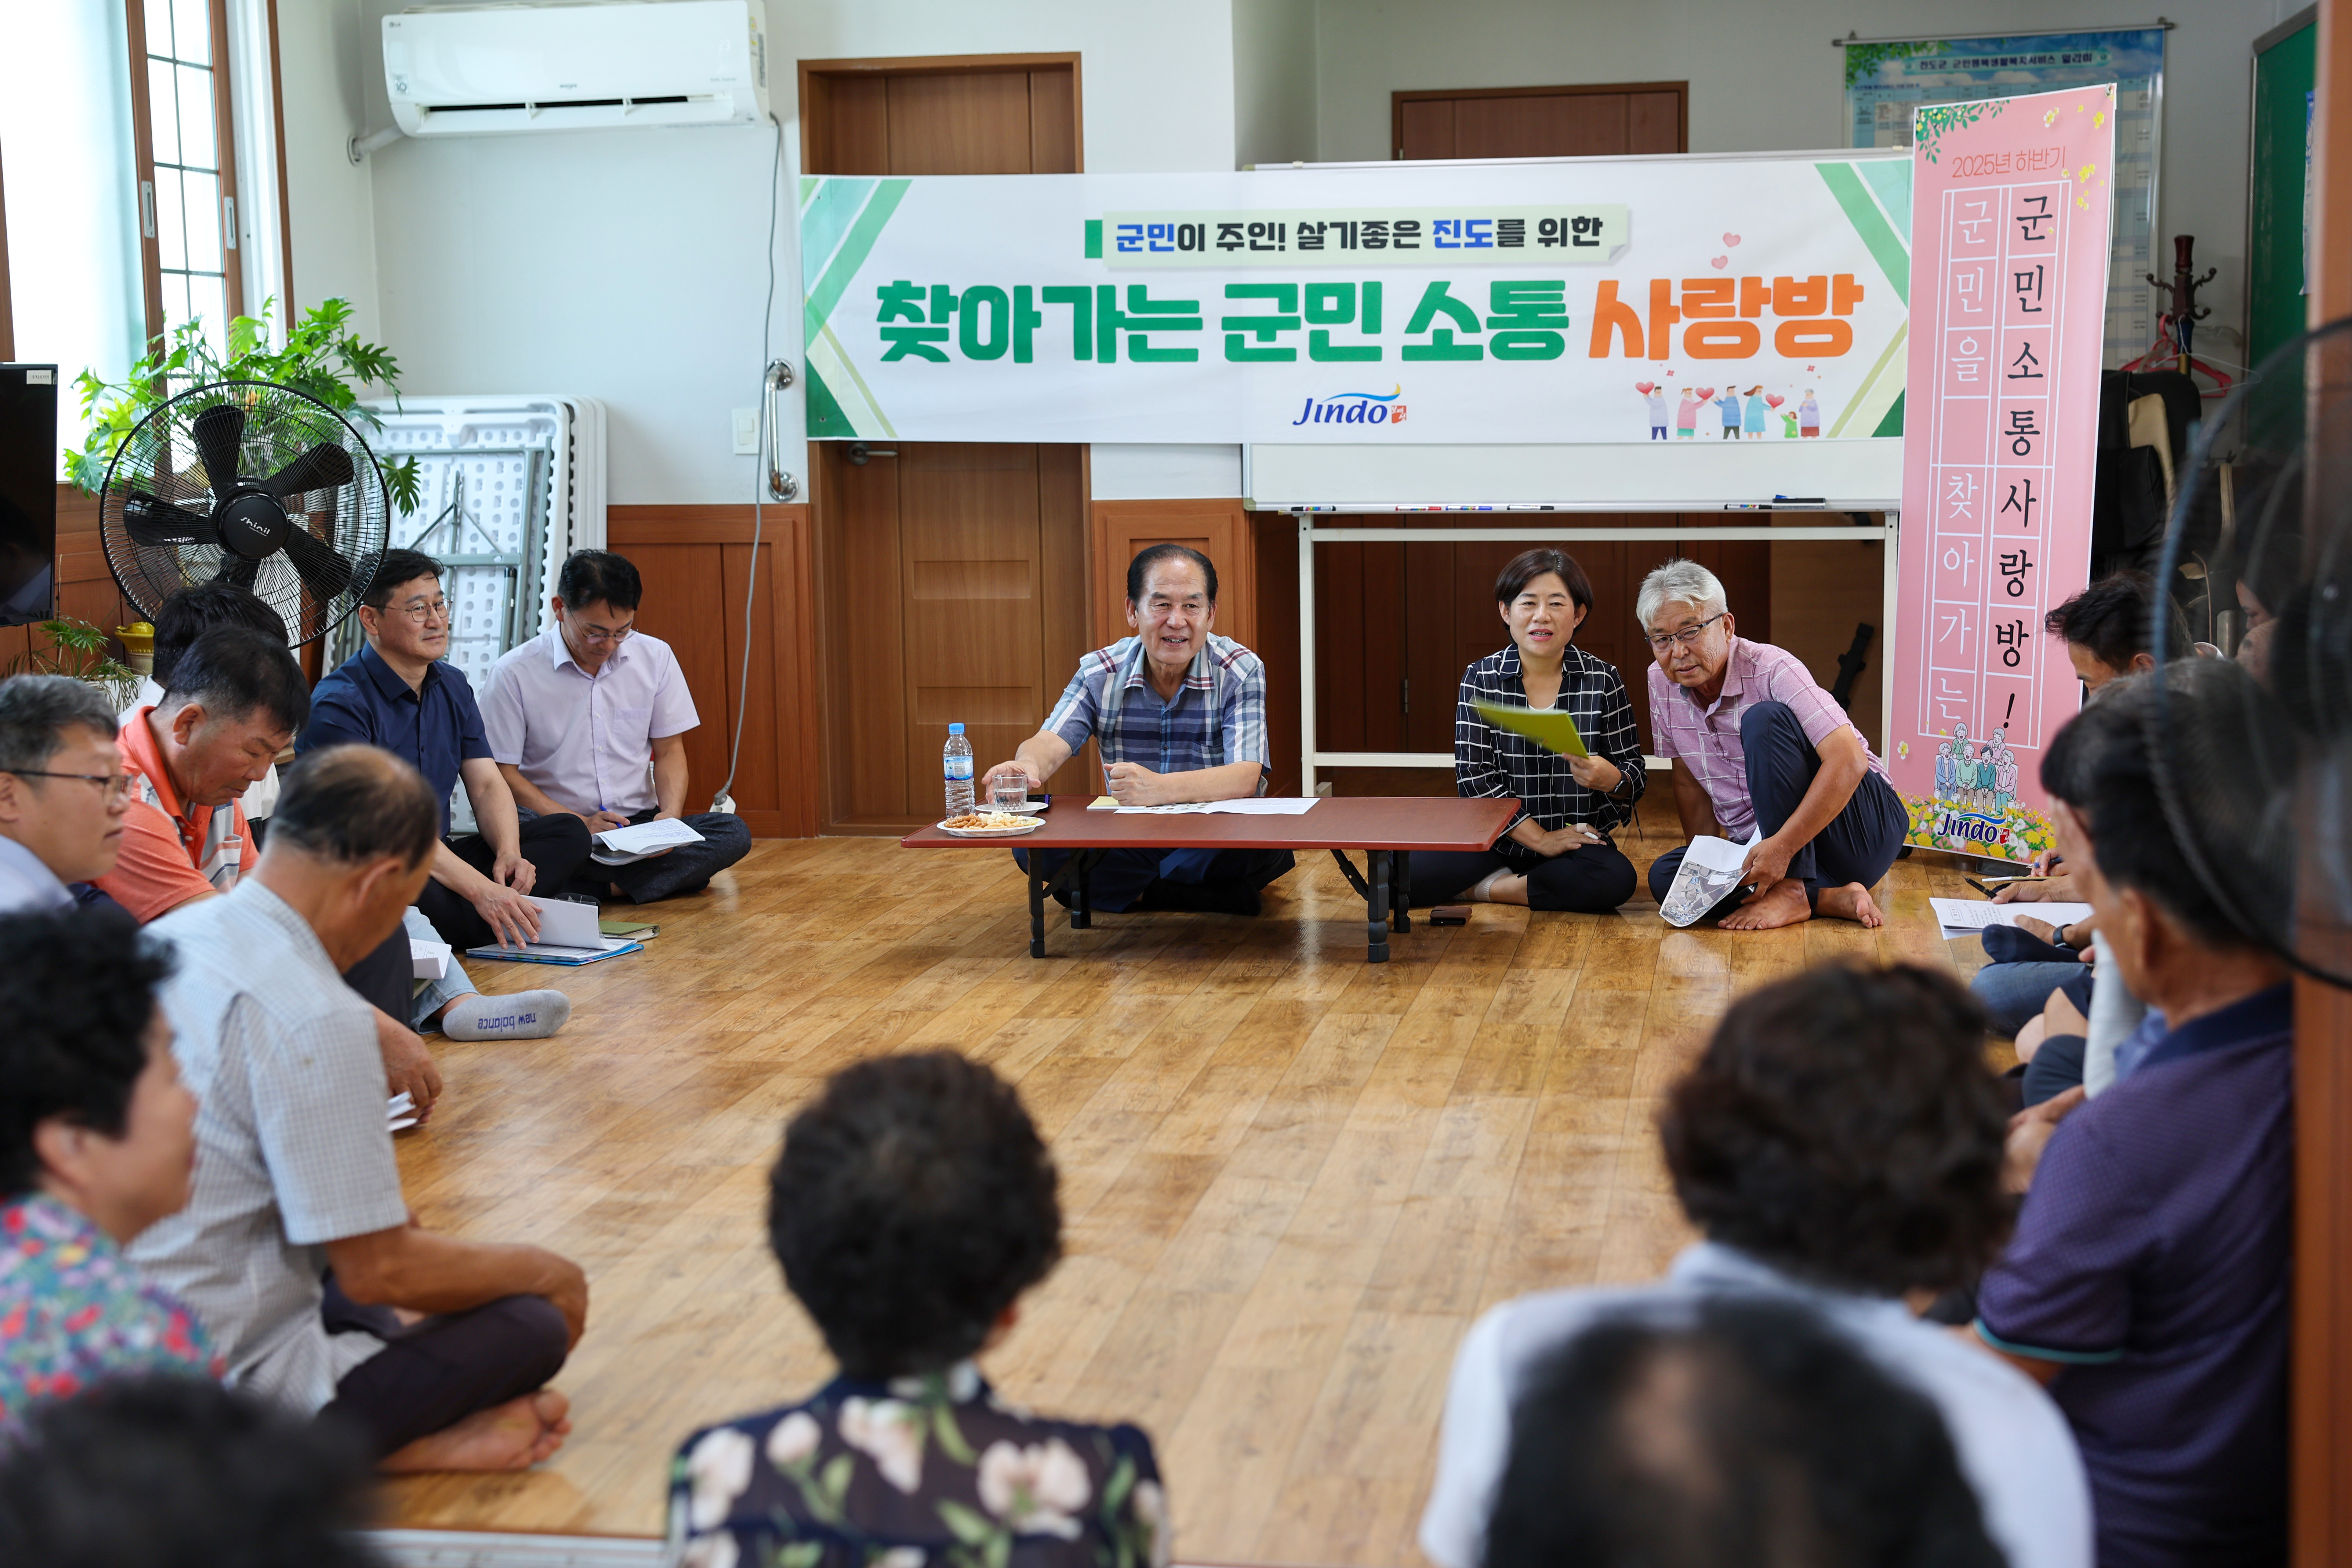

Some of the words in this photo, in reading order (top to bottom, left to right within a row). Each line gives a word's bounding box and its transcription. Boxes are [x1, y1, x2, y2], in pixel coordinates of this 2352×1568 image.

[1952, 152, 2011, 178] 2025년
[2016, 146, 2065, 172] 하반기
[1116, 224, 1205, 252] 군민이
[1216, 223, 1285, 251] 주인!
[1297, 221, 1421, 250] 살기좋은
[1433, 219, 1526, 249] 진도를
[1538, 216, 1603, 247] 위한
[1951, 200, 1993, 382] 군민을
[877, 280, 1203, 363] 찾아가는
[1221, 281, 1382, 362] 군민
[1402, 280, 1569, 361] 소통
[1589, 274, 1864, 360] 사랑방
[1292, 398, 1388, 425] Jindo
[1935, 472, 1978, 720] 찾아가는
[1937, 813, 1997, 842] Jindo
[477, 1015, 515, 1032] balance
[518, 1013, 536, 1024] new
